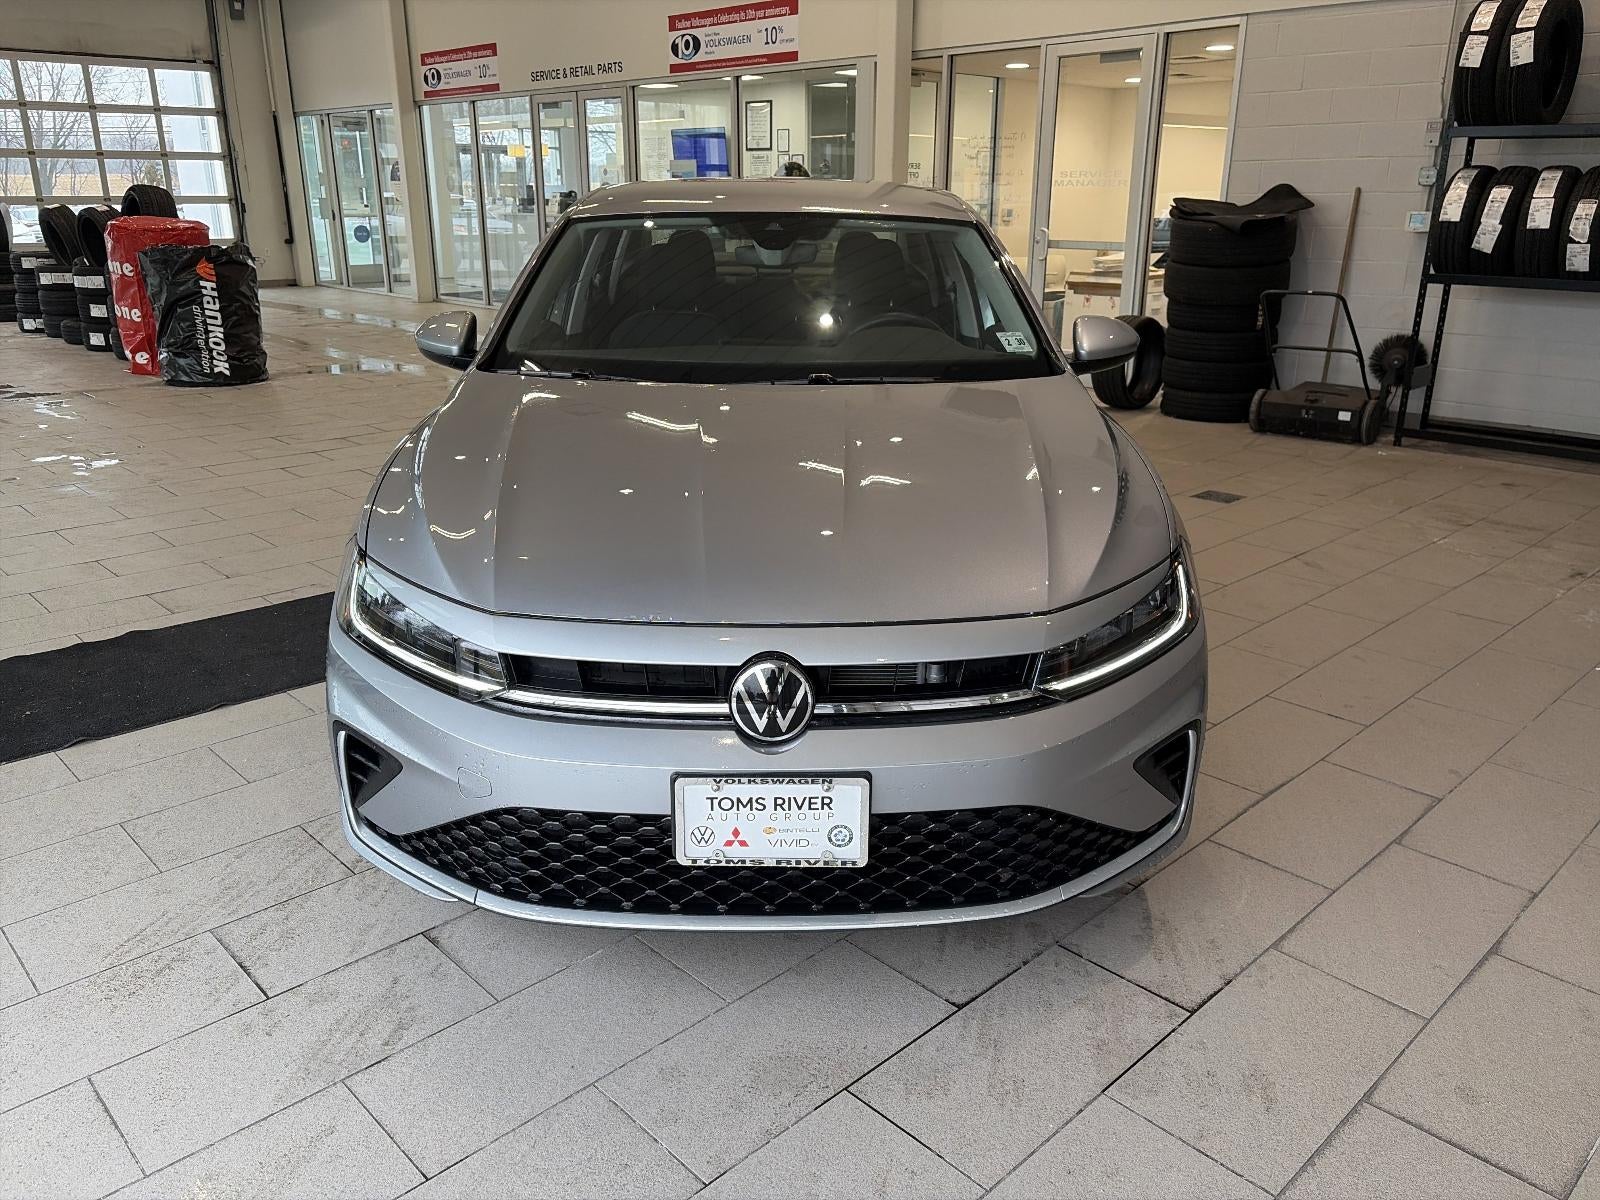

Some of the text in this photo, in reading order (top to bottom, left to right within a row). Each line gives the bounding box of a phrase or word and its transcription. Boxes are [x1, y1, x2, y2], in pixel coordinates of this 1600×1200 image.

[718, 11, 740, 23] Celebrating
[704, 34, 752, 49] VOLKSWAGEN
[530, 61, 624, 82] SERVICE & RETAIL PARTS
[1059, 170, 1123, 179] SERVICE
[1054, 179, 1129, 188] MANAGER
[199, 280, 231, 377] Hankook
[706, 795, 834, 812] TOMS RIVER
[706, 812, 835, 822] AUTO GROUP
[767, 838, 810, 848] VIVID
[685, 858, 859, 867] TOMS RIVER
